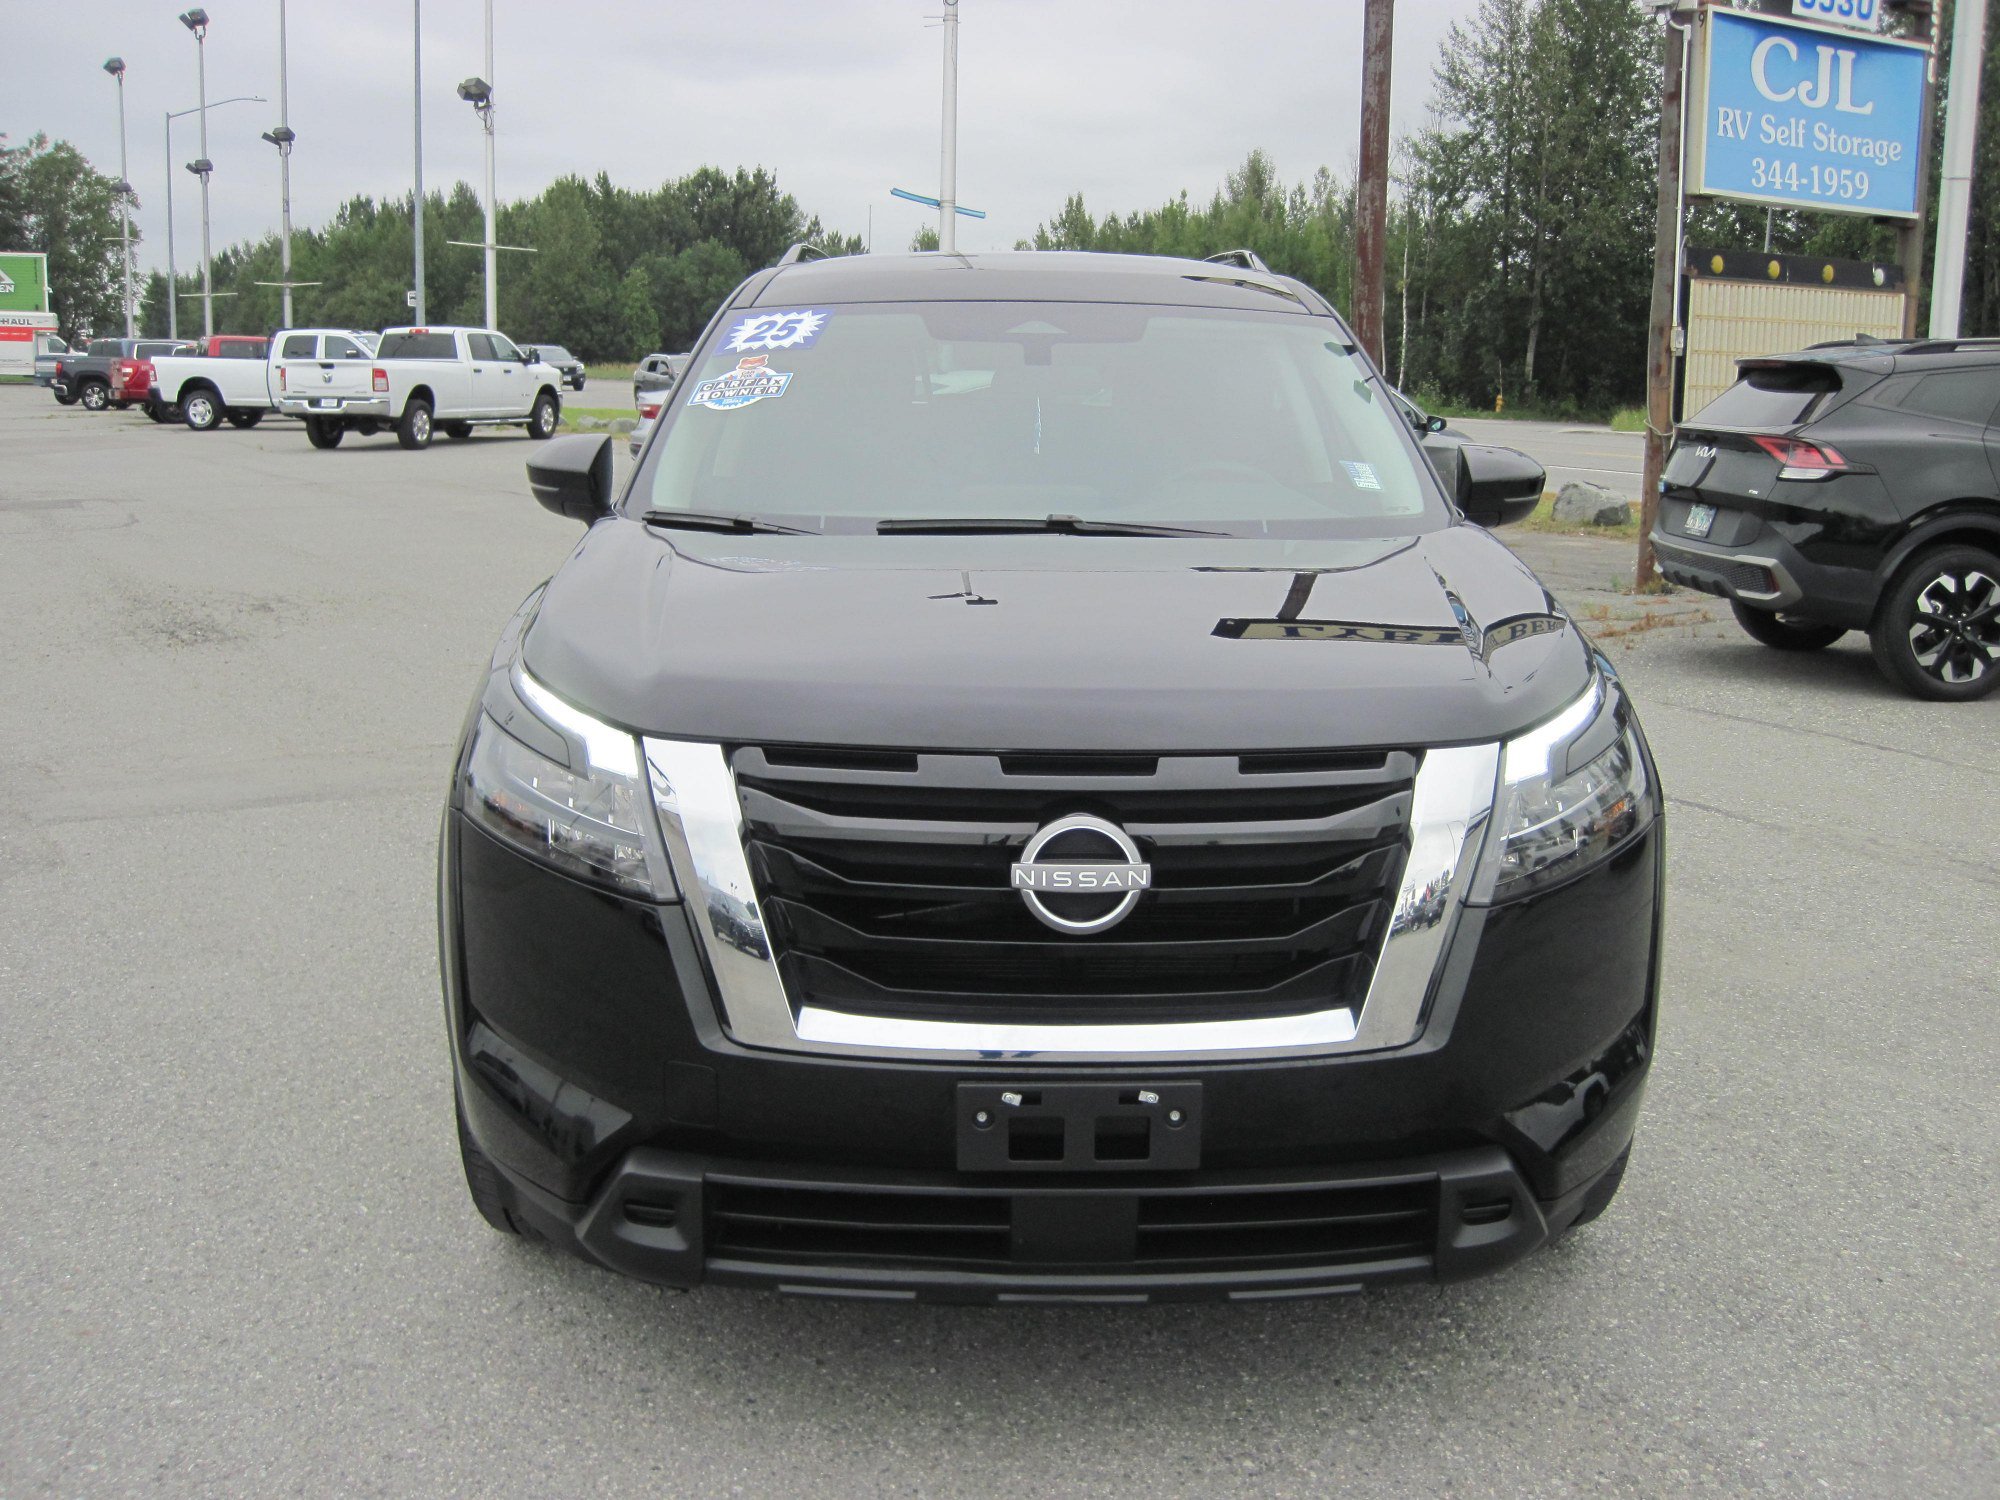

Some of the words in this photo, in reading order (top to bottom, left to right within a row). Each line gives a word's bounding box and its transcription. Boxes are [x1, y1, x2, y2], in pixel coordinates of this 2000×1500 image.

[1751, 36, 1874, 115] CJL
[1717, 107, 1752, 140] RV
[1759, 113, 1806, 148] Self
[1813, 122, 1902, 166] Storage
[1751, 157, 1869, 200] 344-1959
[742, 319, 804, 344] 25
[703, 376, 785, 391] CARFAX
[710, 386, 777, 399] OWNER
[1015, 869, 1147, 887] NISSAN
